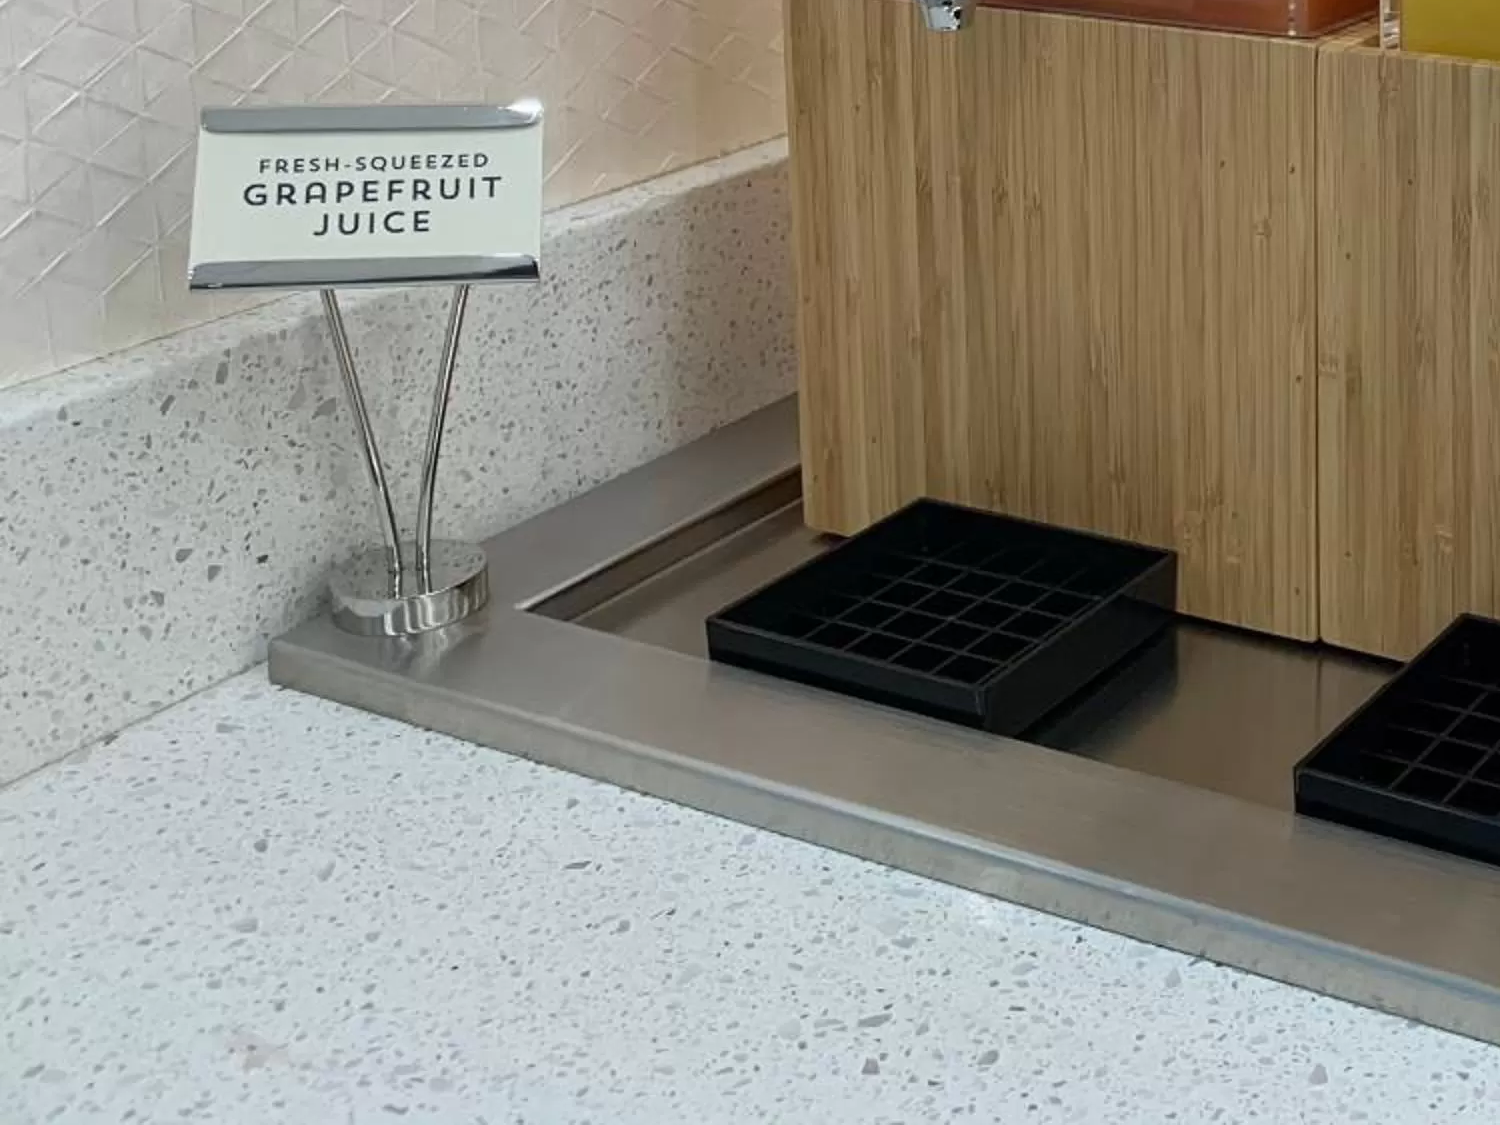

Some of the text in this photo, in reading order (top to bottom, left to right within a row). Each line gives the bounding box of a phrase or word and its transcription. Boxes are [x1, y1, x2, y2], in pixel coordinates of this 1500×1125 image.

[259, 152, 489, 174] FRESH-SQUEEZED
[243, 175, 502, 207] GRAPEFRUIT
[312, 210, 431, 237] JUICE
